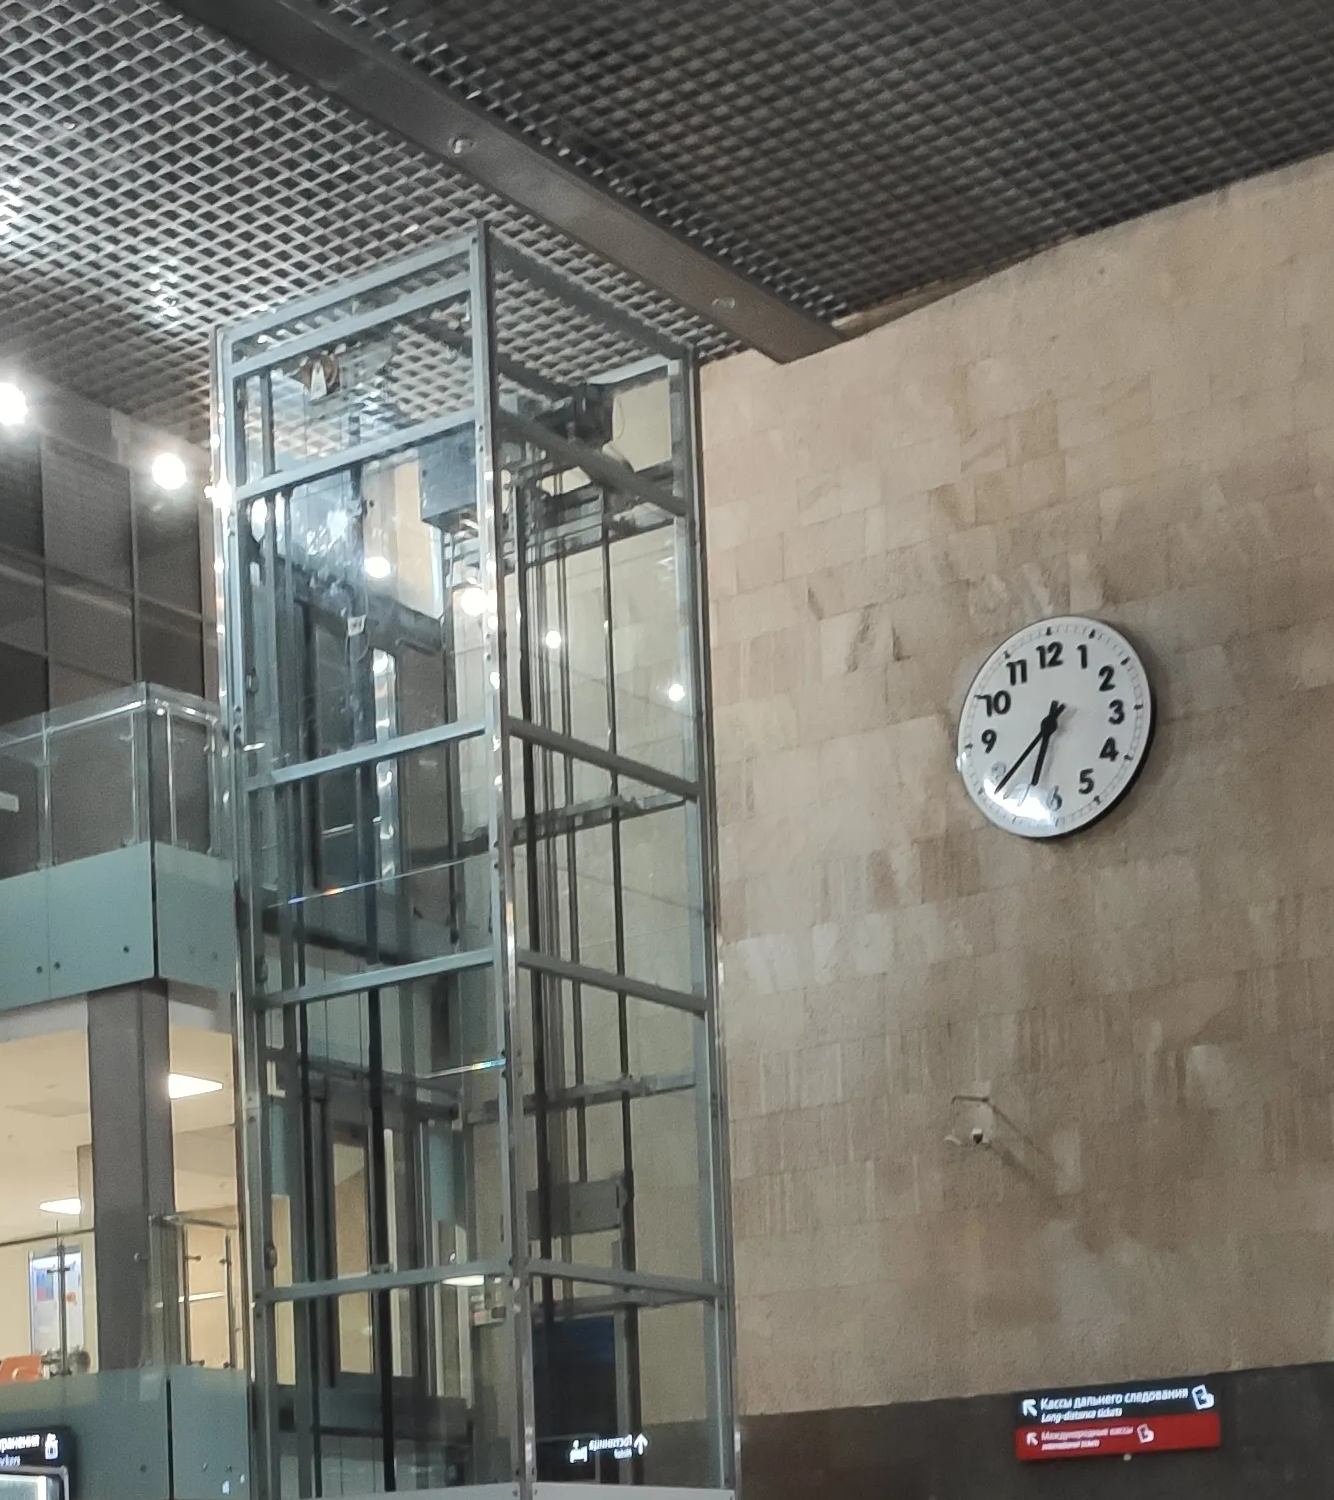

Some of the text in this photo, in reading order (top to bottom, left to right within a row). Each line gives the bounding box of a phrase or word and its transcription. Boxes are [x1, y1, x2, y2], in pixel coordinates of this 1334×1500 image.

[1035, 641, 1064, 670] 12
[1076, 644, 1088, 669] 1
[1006, 659, 1028, 686] 11
[1098, 665, 1116, 692] 2
[981, 690, 1011, 717] 10
[1108, 699, 1126, 725] 3
[981, 729, 997, 755] 9
[1099, 737, 1119, 762] 4
[1078, 768, 1095, 795] 5
[1046, 785, 1063, 811] 6
[1041, 1388, 1189, 1411] Кассы дальнего следования
